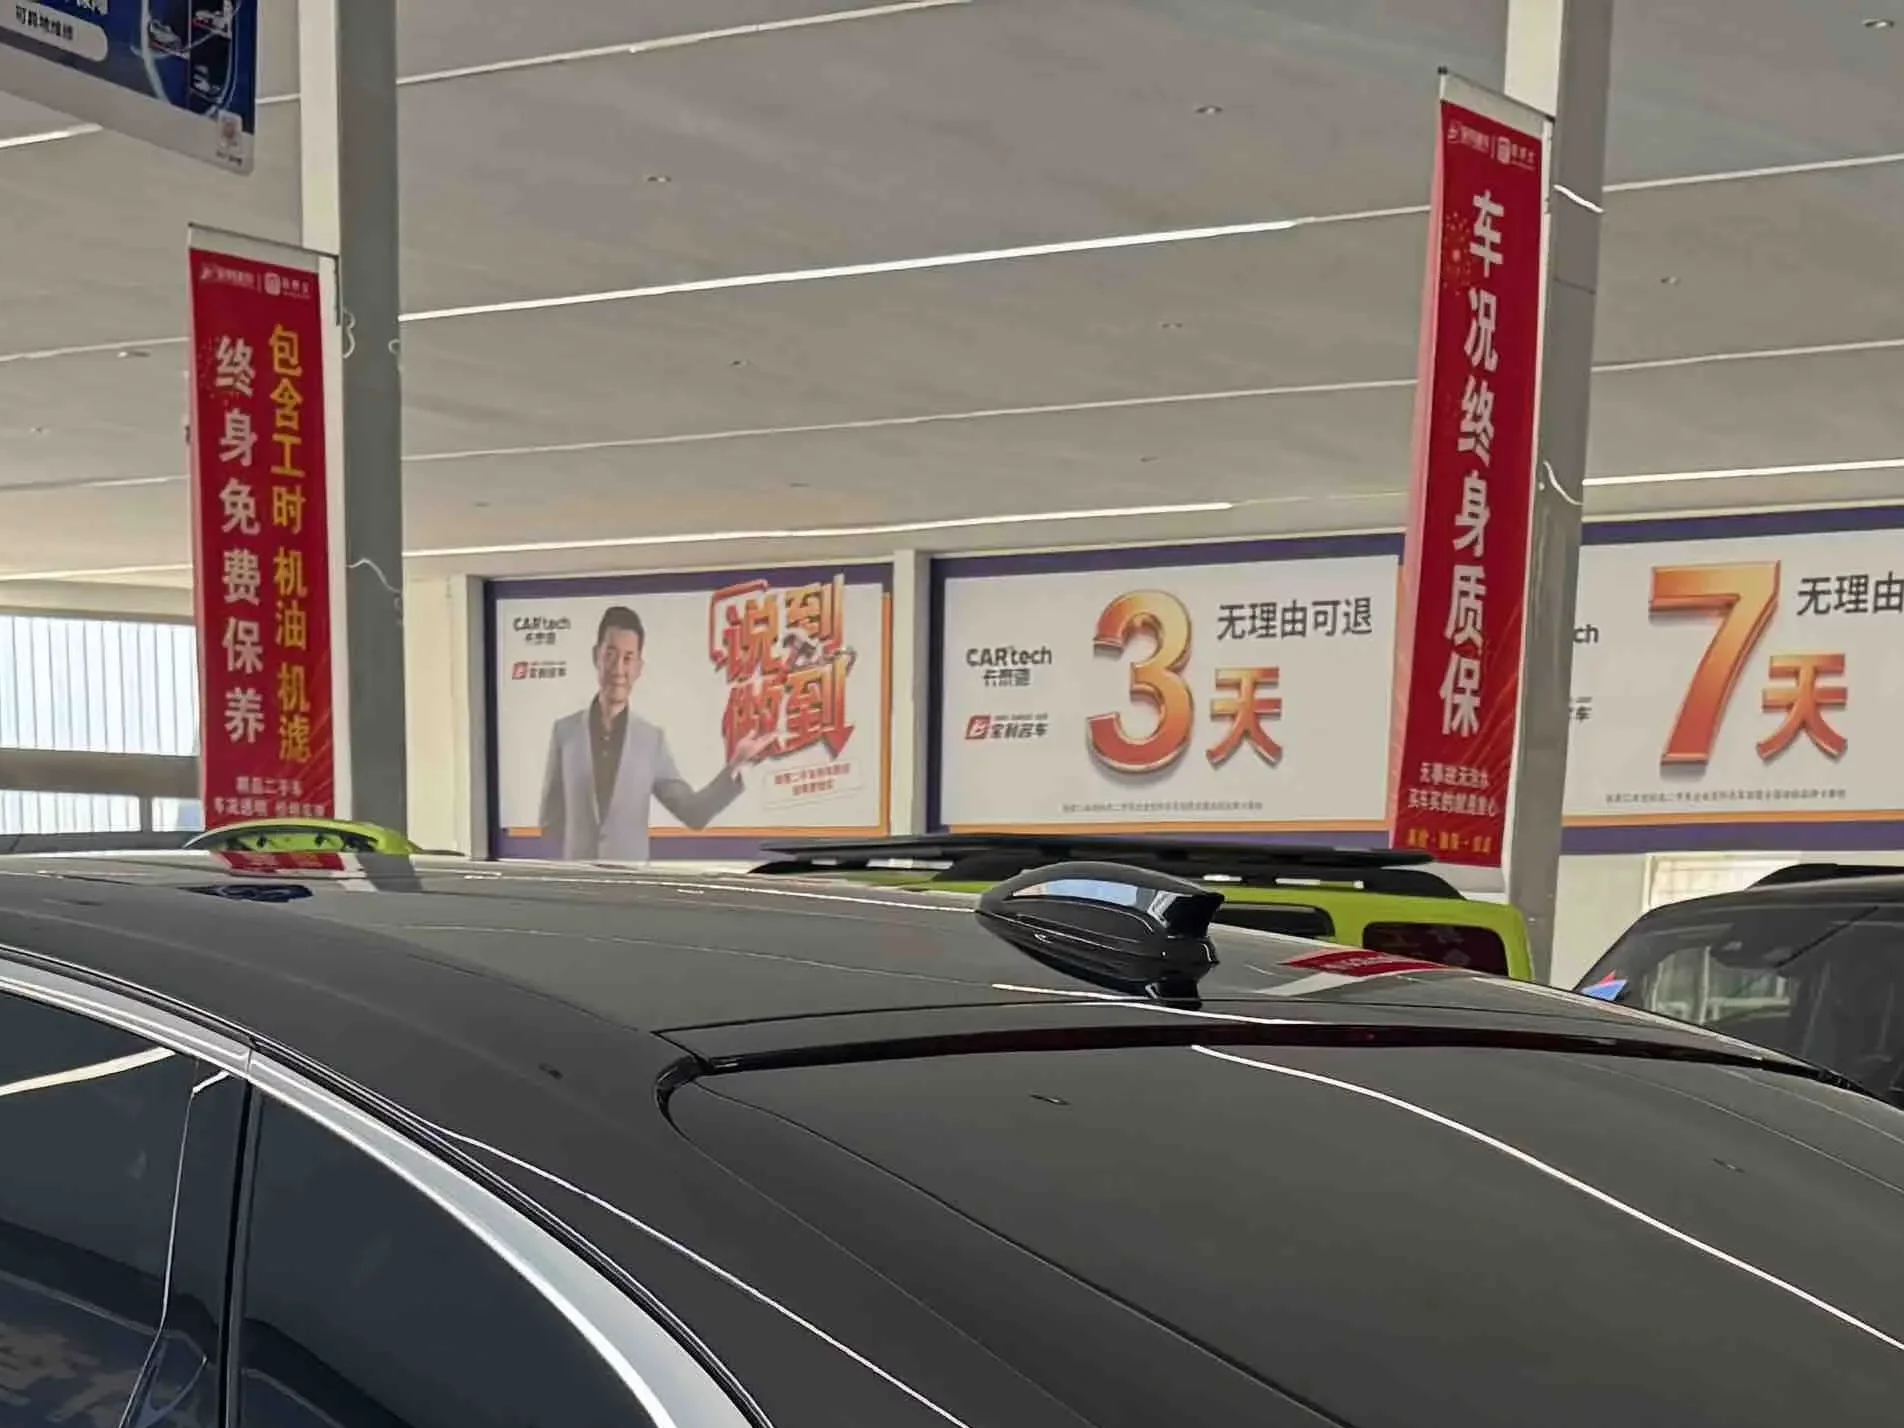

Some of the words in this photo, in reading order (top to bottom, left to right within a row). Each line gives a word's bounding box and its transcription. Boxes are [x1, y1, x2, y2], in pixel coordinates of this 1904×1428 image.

[267, 324, 306, 536] 包含工时
[1440, 190, 1505, 738] 车况终身质保
[214, 335, 265, 744] 终身免费保养
[272, 546, 307, 652] 机油
[1216, 597, 1374, 642] 无理由可退
[965, 644, 1053, 667] CARtech
[1087, 589, 1283, 774] 3天
[1649, 560, 1849, 767] 7天
